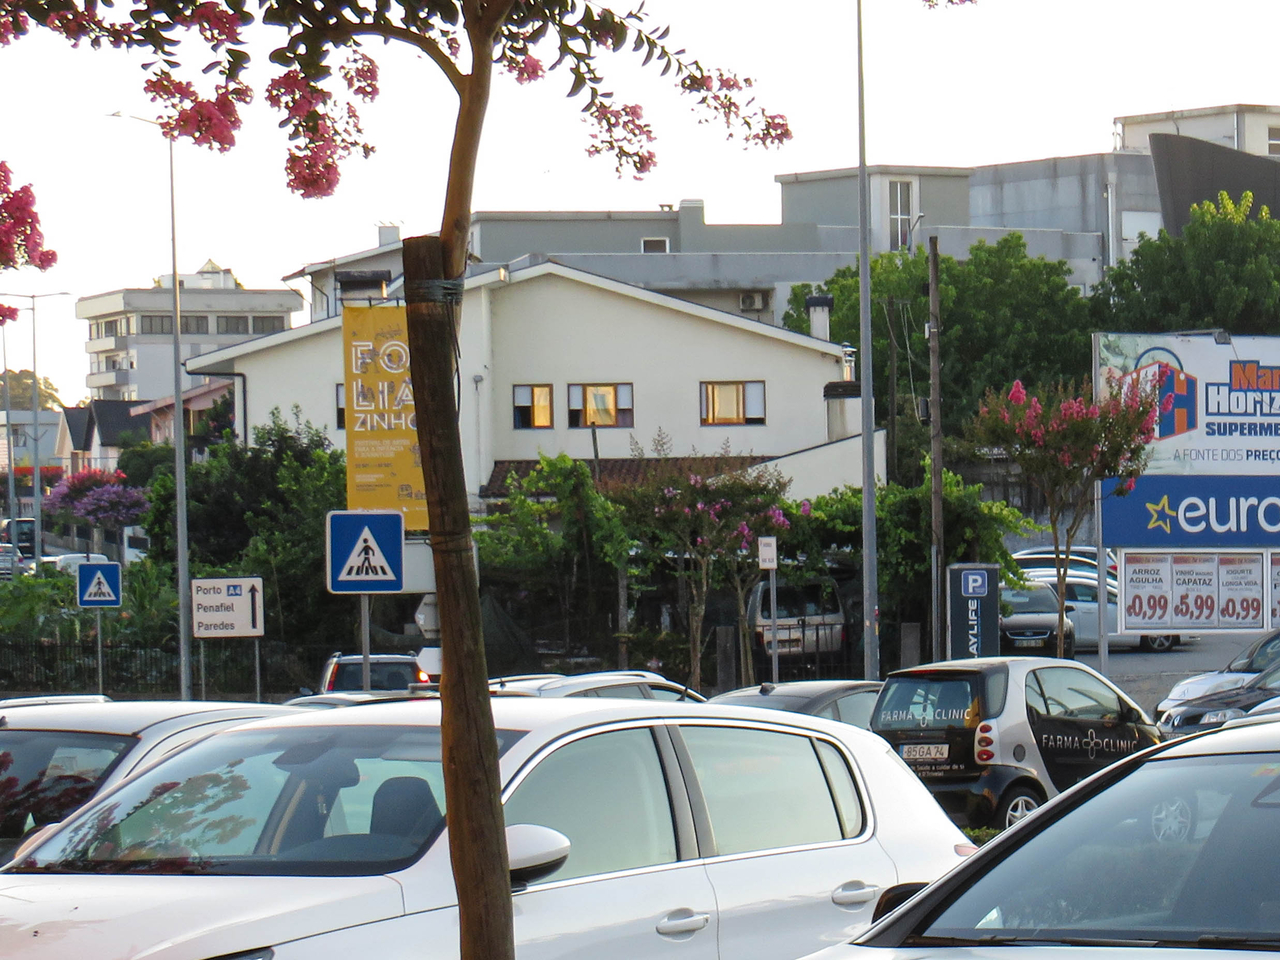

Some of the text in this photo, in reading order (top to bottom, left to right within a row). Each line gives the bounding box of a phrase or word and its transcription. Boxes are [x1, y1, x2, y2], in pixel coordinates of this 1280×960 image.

[1174, 450, 1181, 460] A
[1184, 449, 1218, 460] FONTE
[1221, 449, 1243, 460] DOS
[968, 575, 982, 593] P
[1175, 578, 1212, 586] CAPATAZ
[196, 586, 242, 595] Porto A4
[197, 603, 235, 613] Penafiel
[198, 621, 235, 631] Paredes
[968, 599, 978, 658] AYLIFE
[881, 708, 971, 721] FARMA CLINIC
[1042, 735, 1138, 753] FARMA CLINIC
